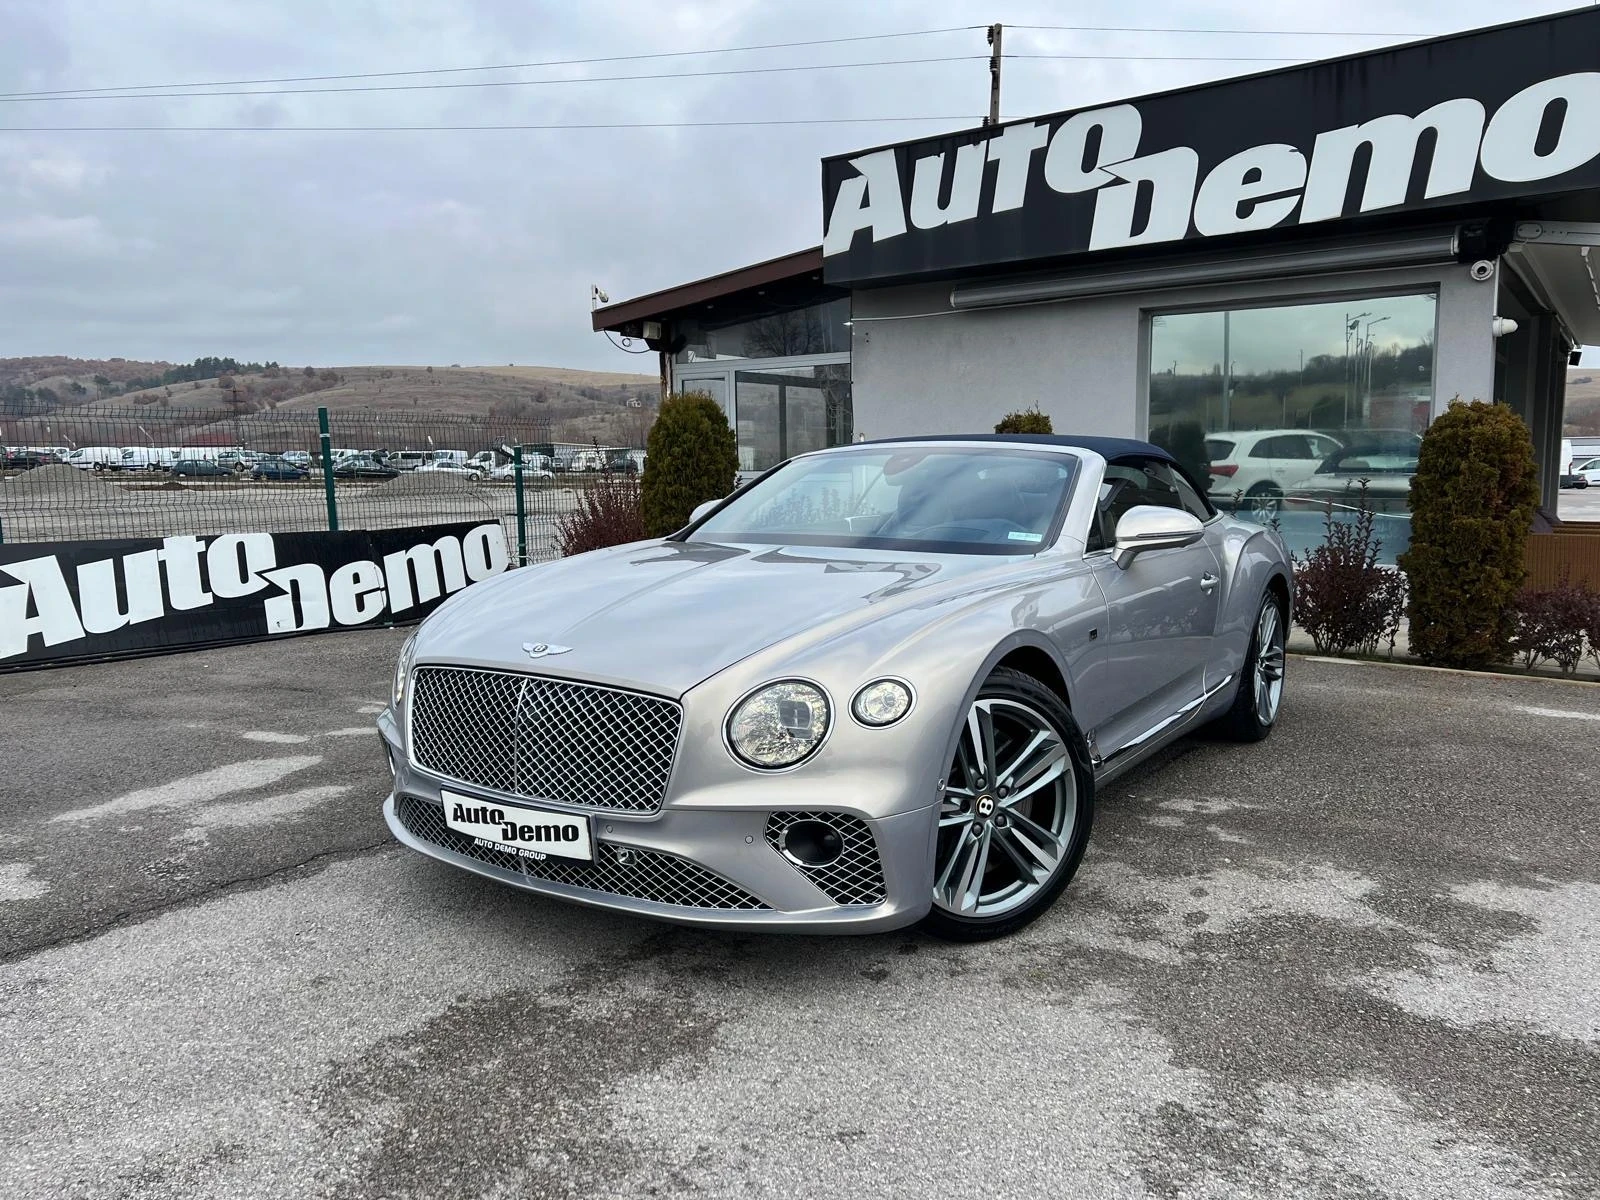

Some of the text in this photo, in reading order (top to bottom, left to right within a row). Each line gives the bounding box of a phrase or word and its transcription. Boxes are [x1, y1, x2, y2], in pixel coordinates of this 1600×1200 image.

[823, 72, 1600, 257] Auto Demo
[0, 523, 508, 660] Auto Demo
[452, 803, 580, 842] Auto Demo
[474, 838, 547, 861] AUTO DEMO GROUP
